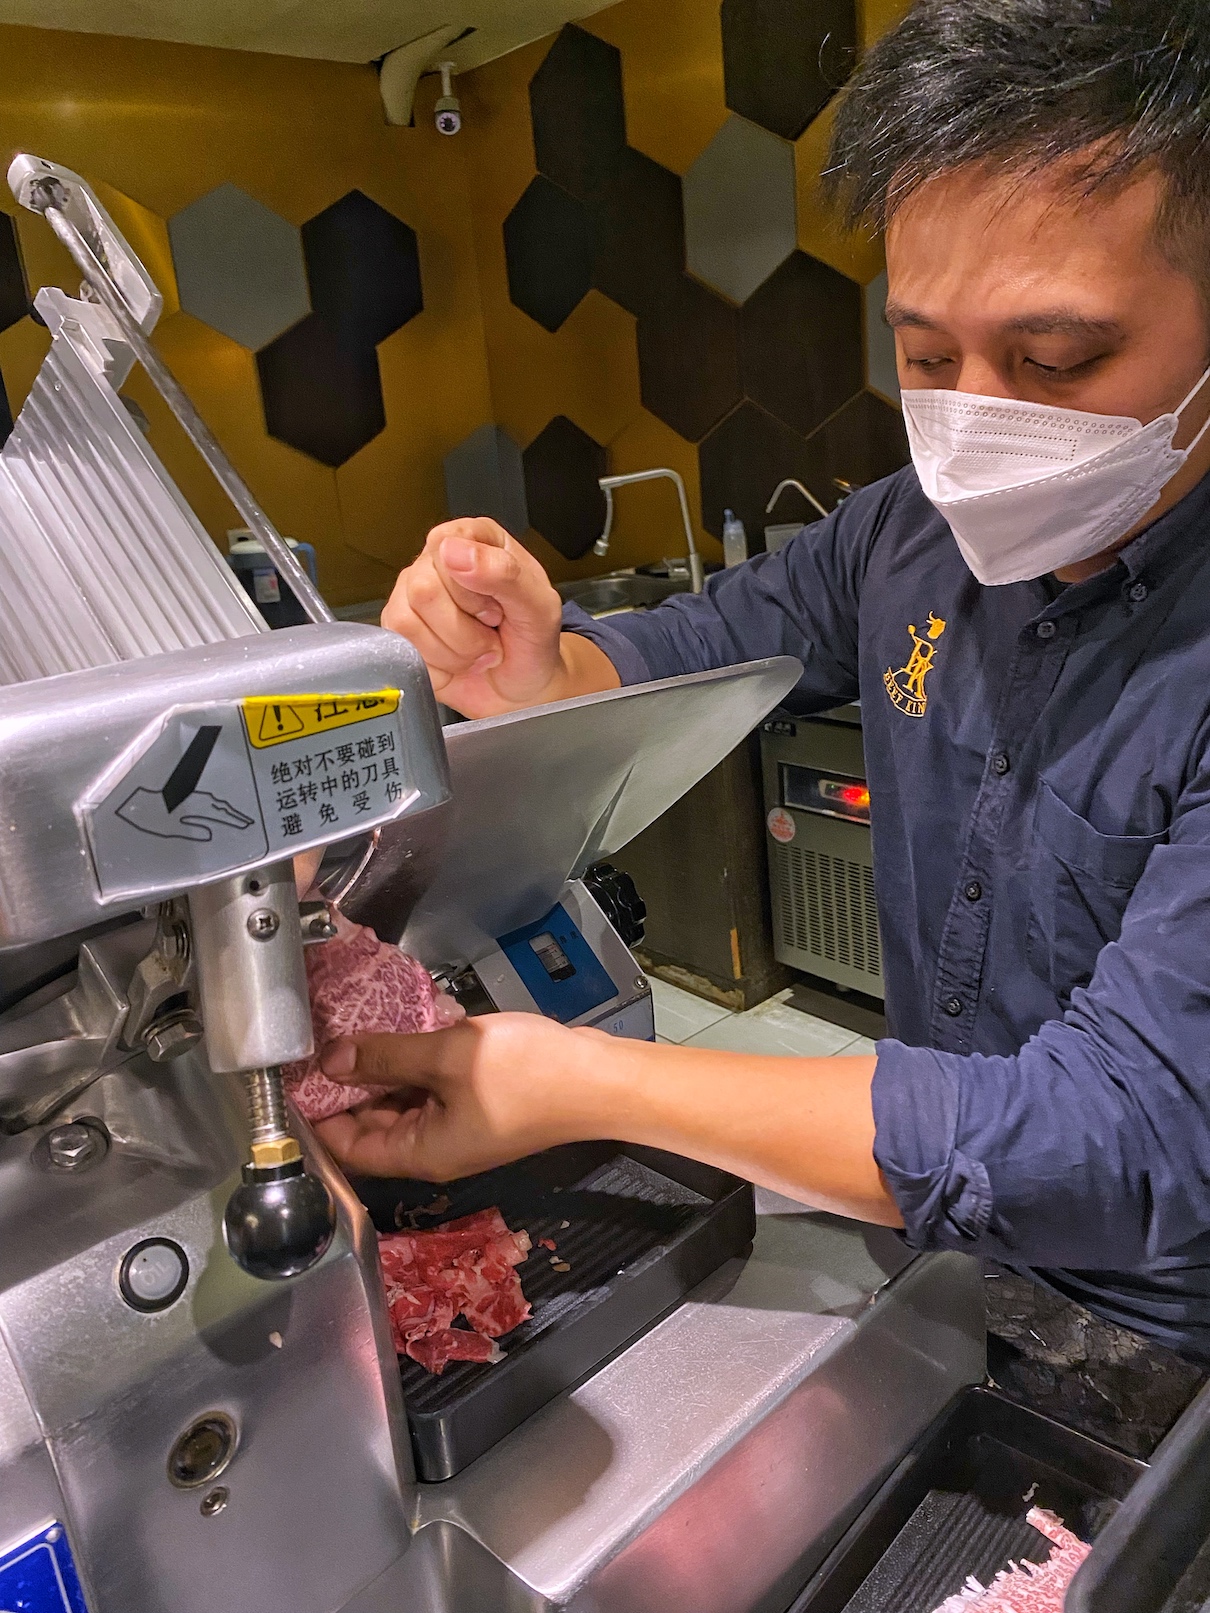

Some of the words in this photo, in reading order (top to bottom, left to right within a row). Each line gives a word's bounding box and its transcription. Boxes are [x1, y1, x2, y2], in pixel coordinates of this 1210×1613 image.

[905, 700, 926, 714] KIN
[271, 731, 395, 784] 绝对不要碰到
[276, 757, 400, 812] 运转中的刀具
[281, 781, 402, 837] 避免受伤
[140, 1262, 171, 1287] OIL
